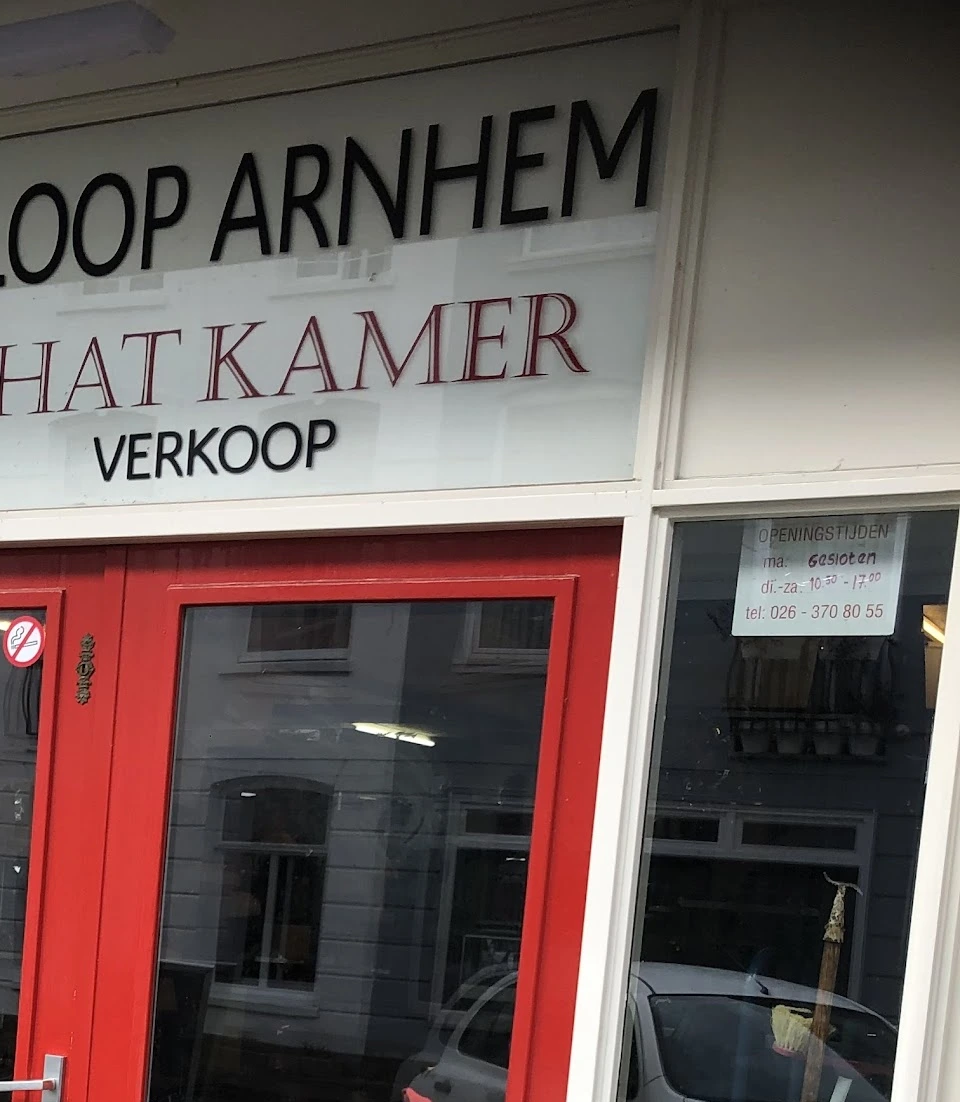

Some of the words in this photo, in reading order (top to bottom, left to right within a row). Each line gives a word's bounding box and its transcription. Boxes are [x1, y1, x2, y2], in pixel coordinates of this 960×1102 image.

[209, 87, 659, 262] ARNHEM
[198, 292, 591, 403] KAMER
[92, 419, 338, 483] VERKOOP
[759, 524, 889, 543] OPENINGSTIJDEN
[808, 552, 876, 568] Gesloten
[746, 606, 765, 620] tel:
[770, 606, 796, 619] 026
[811, 604, 838, 619] 370
[843, 605, 860, 618] 80
[866, 604, 883, 618] 55
